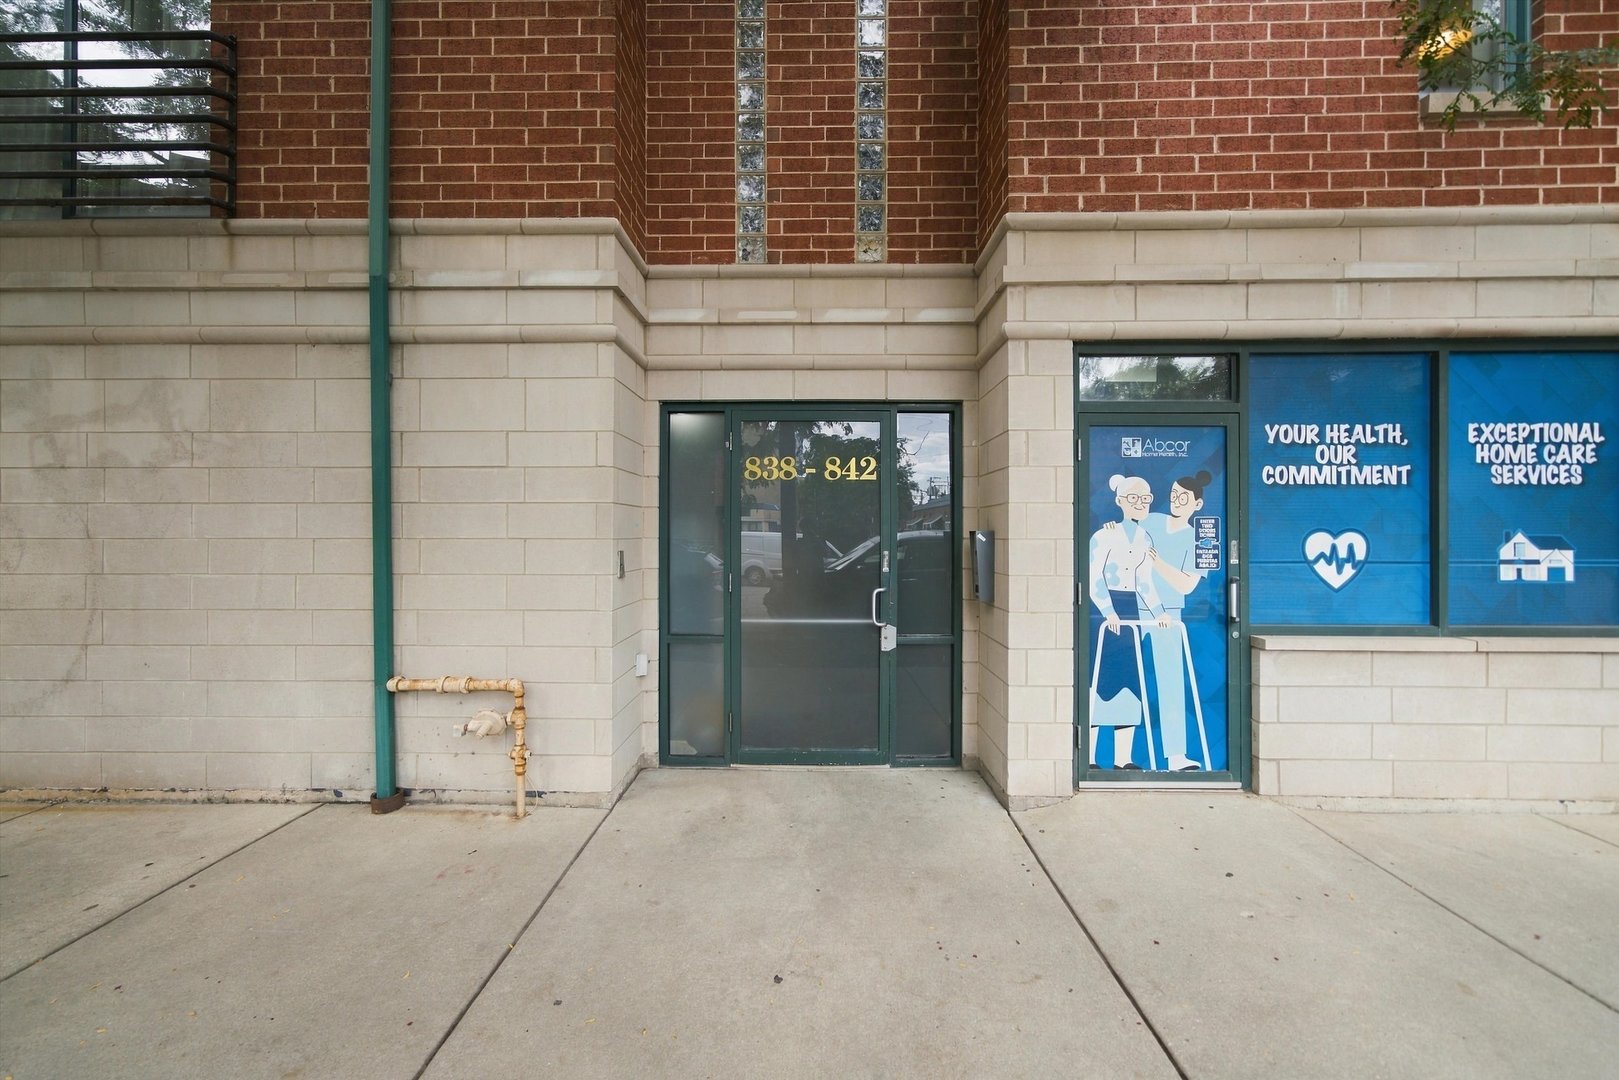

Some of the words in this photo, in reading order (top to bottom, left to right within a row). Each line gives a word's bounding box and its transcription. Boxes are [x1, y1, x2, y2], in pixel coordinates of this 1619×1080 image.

[1265, 423, 1320, 445] YOUR
[1325, 424, 1409, 446] HEALTH,
[1468, 422, 1605, 444] EXCEPTIONAL
[1142, 437, 1191, 452] Abcor
[1315, 444, 1357, 465] OUR
[1476, 443, 1537, 465] HOME
[1543, 443, 1598, 464] CARE
[744, 456, 798, 481] 838
[824, 456, 877, 481] 842
[1262, 464, 1412, 486] COMMITMENT
[1490, 463, 1583, 485] SERVICES
